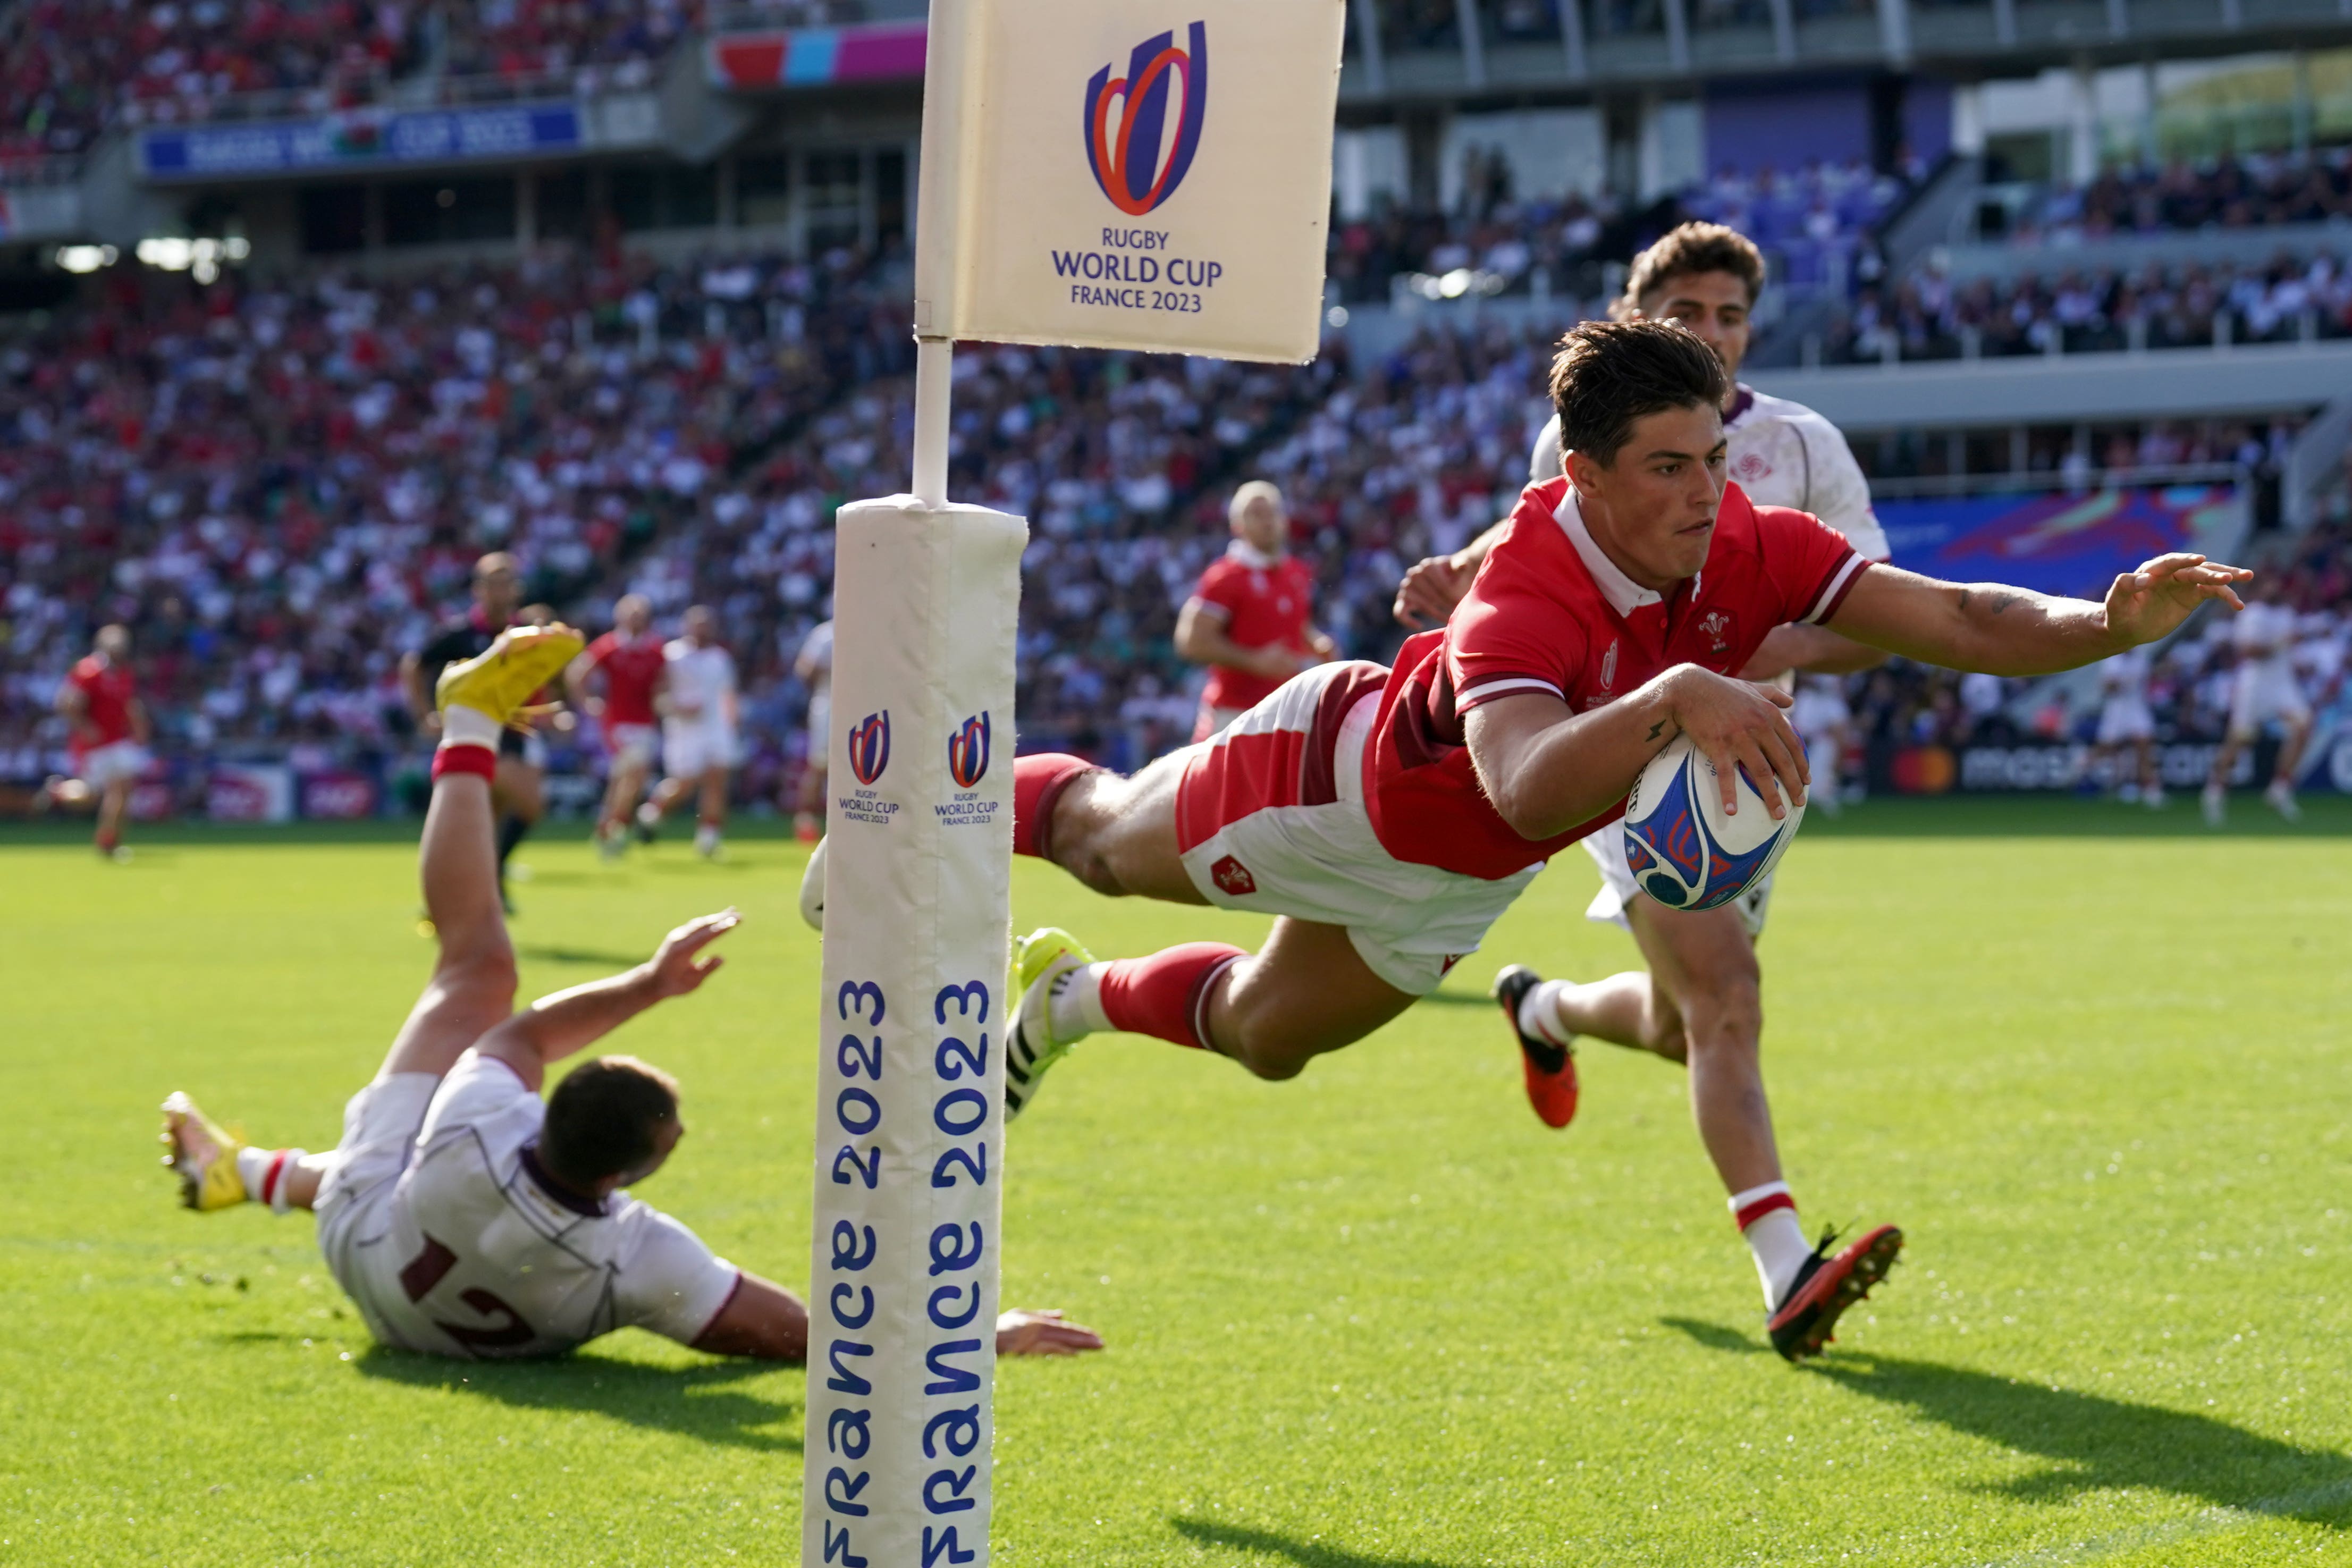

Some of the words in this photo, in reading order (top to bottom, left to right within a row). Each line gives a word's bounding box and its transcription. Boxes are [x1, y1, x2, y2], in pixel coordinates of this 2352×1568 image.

[1102, 227, 1169, 250] RUGBY
[1051, 250, 1159, 283] WORLD
[1166, 258, 1223, 288] CUP
[1072, 284, 1145, 308] FRANCE
[1151, 290, 1202, 313] 2023
[855, 789, 878, 799] RUGBY
[954, 793, 978, 801] RUGBY
[839, 798, 874, 812] WORLD
[875, 802, 899, 814] CUP
[934, 803, 974, 815] WORLD
[977, 801, 999, 813] CUP
[845, 812, 870, 822] FRANCE
[871, 815, 889, 824] 2023
[942, 816, 971, 826] FRANCE
[972, 815, 991, 824] 2023
[832, 980, 886, 1190] 2023
[931, 980, 990, 1188] 2023
[399, 1230, 536, 1346] 12
